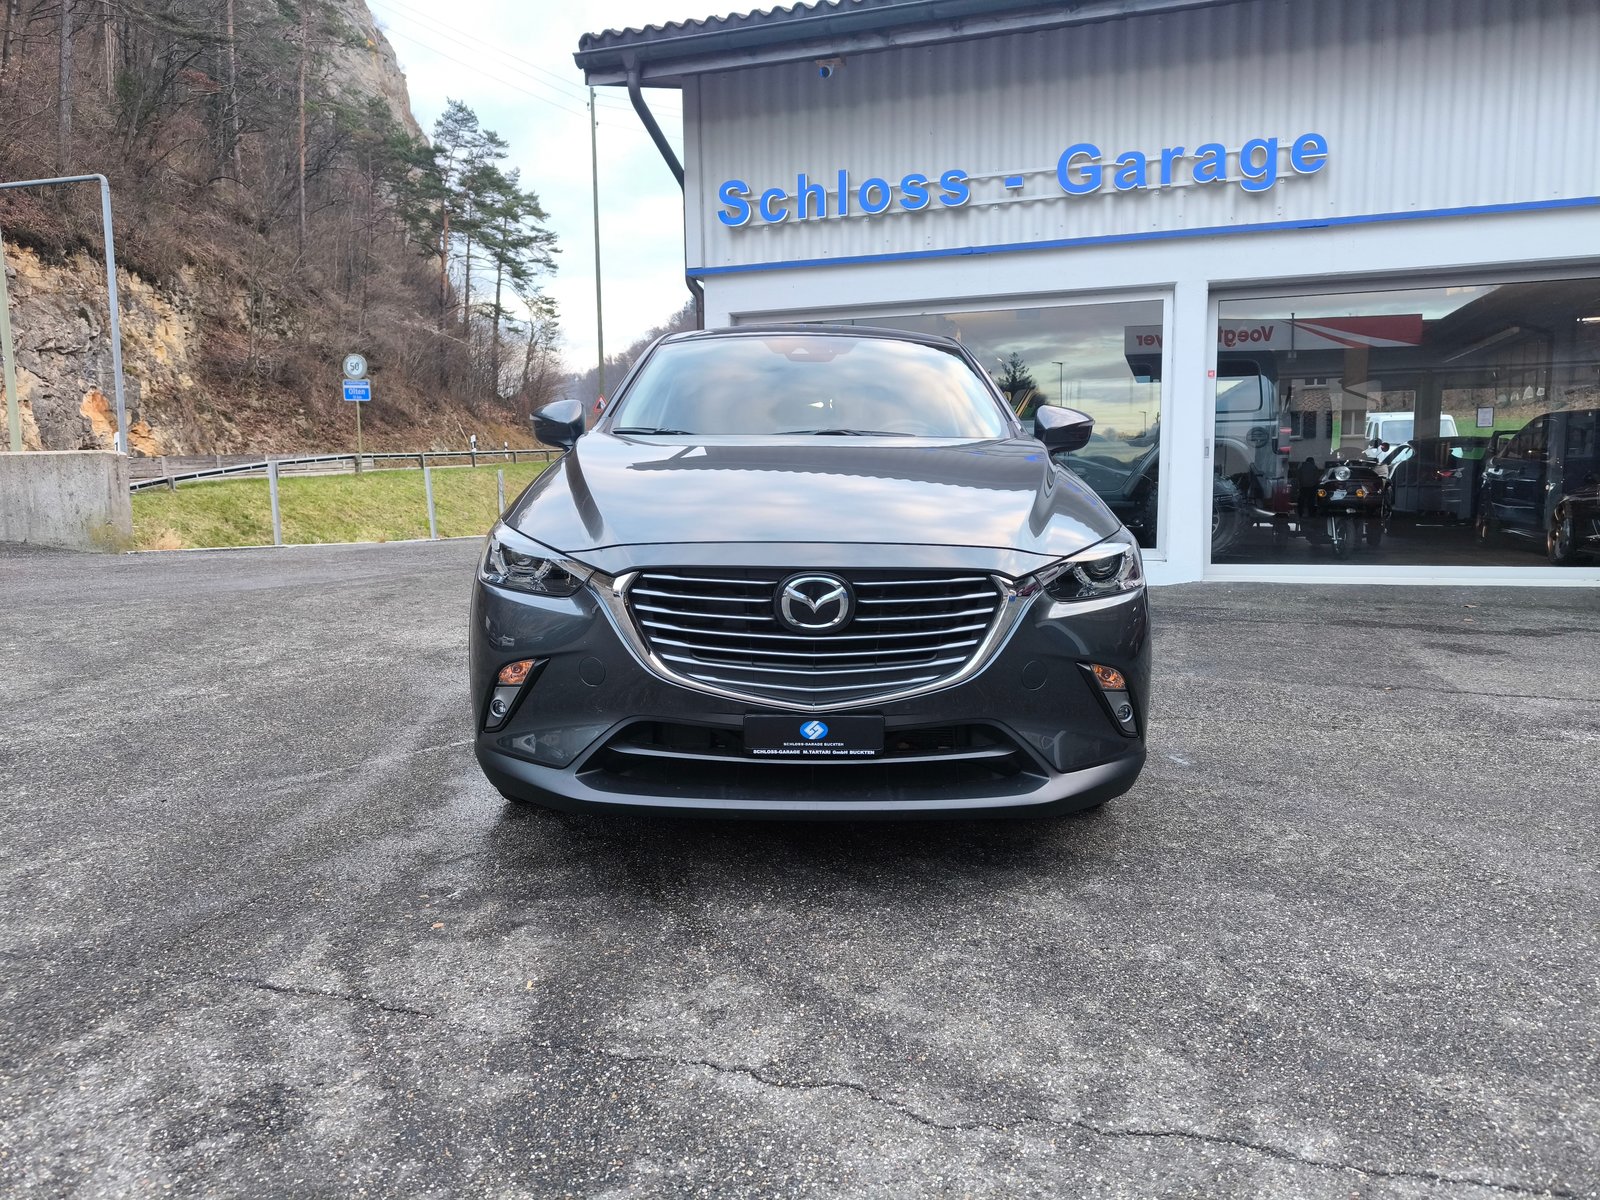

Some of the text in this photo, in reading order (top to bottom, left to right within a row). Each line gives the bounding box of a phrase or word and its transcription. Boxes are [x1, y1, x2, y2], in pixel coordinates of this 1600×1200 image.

[716, 168, 971, 227] Schloss
[1055, 131, 1329, 193] Garage
[349, 362, 360, 371] 50
